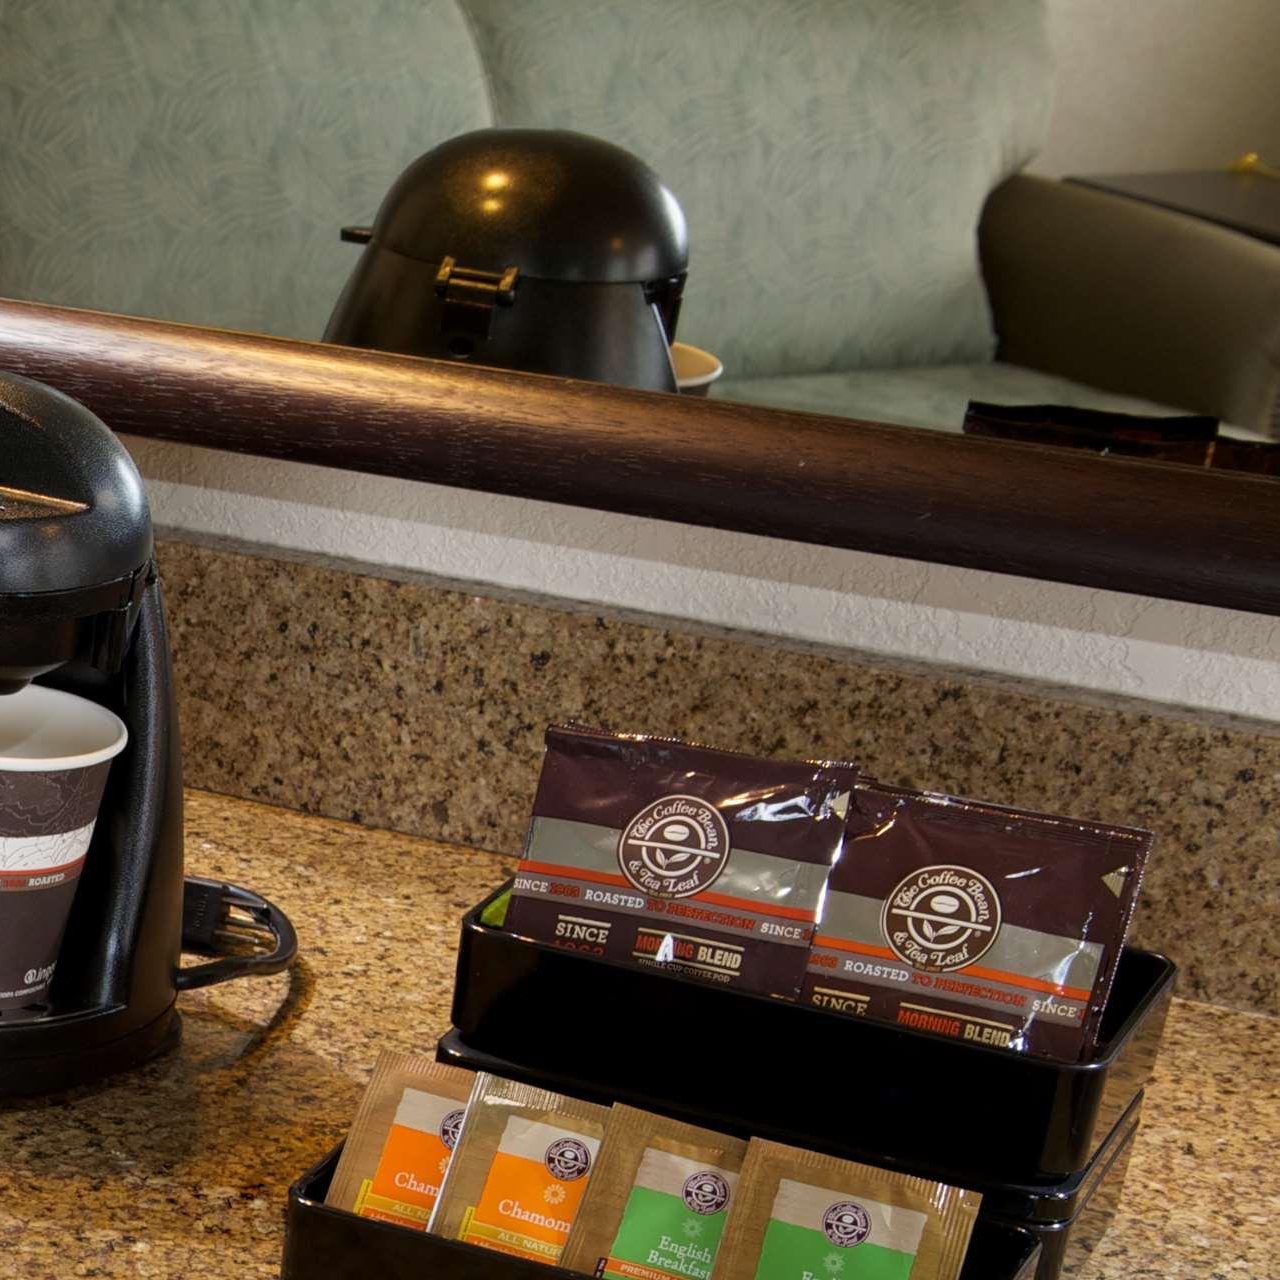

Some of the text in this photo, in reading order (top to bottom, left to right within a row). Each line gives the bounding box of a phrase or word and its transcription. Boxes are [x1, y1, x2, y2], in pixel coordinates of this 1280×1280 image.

[631, 801, 720, 849] The Coffee Bean
[28, 873, 66, 887] ROASTED
[629, 860, 700, 893] & Tea Leaf
[513, 877, 548, 893] SINCE
[585, 889, 645, 909] ROASTED
[761, 922, 802, 939] SINCE
[893, 871, 990, 922] The Coffee Bean
[555, 922, 609, 945] SINCE
[893, 930, 970, 966] & Tea Leaf
[697, 946, 741, 969] BLEND
[843, 960, 909, 982] ROASTED
[1032, 999, 1077, 1018] SINCE
[896, 1009, 1011, 1048] MORNING BLEND
[498, 1199, 572, 1233] Chamom
[497, 1231, 519, 1244] ALL
[658, 1235, 712, 1265] English
